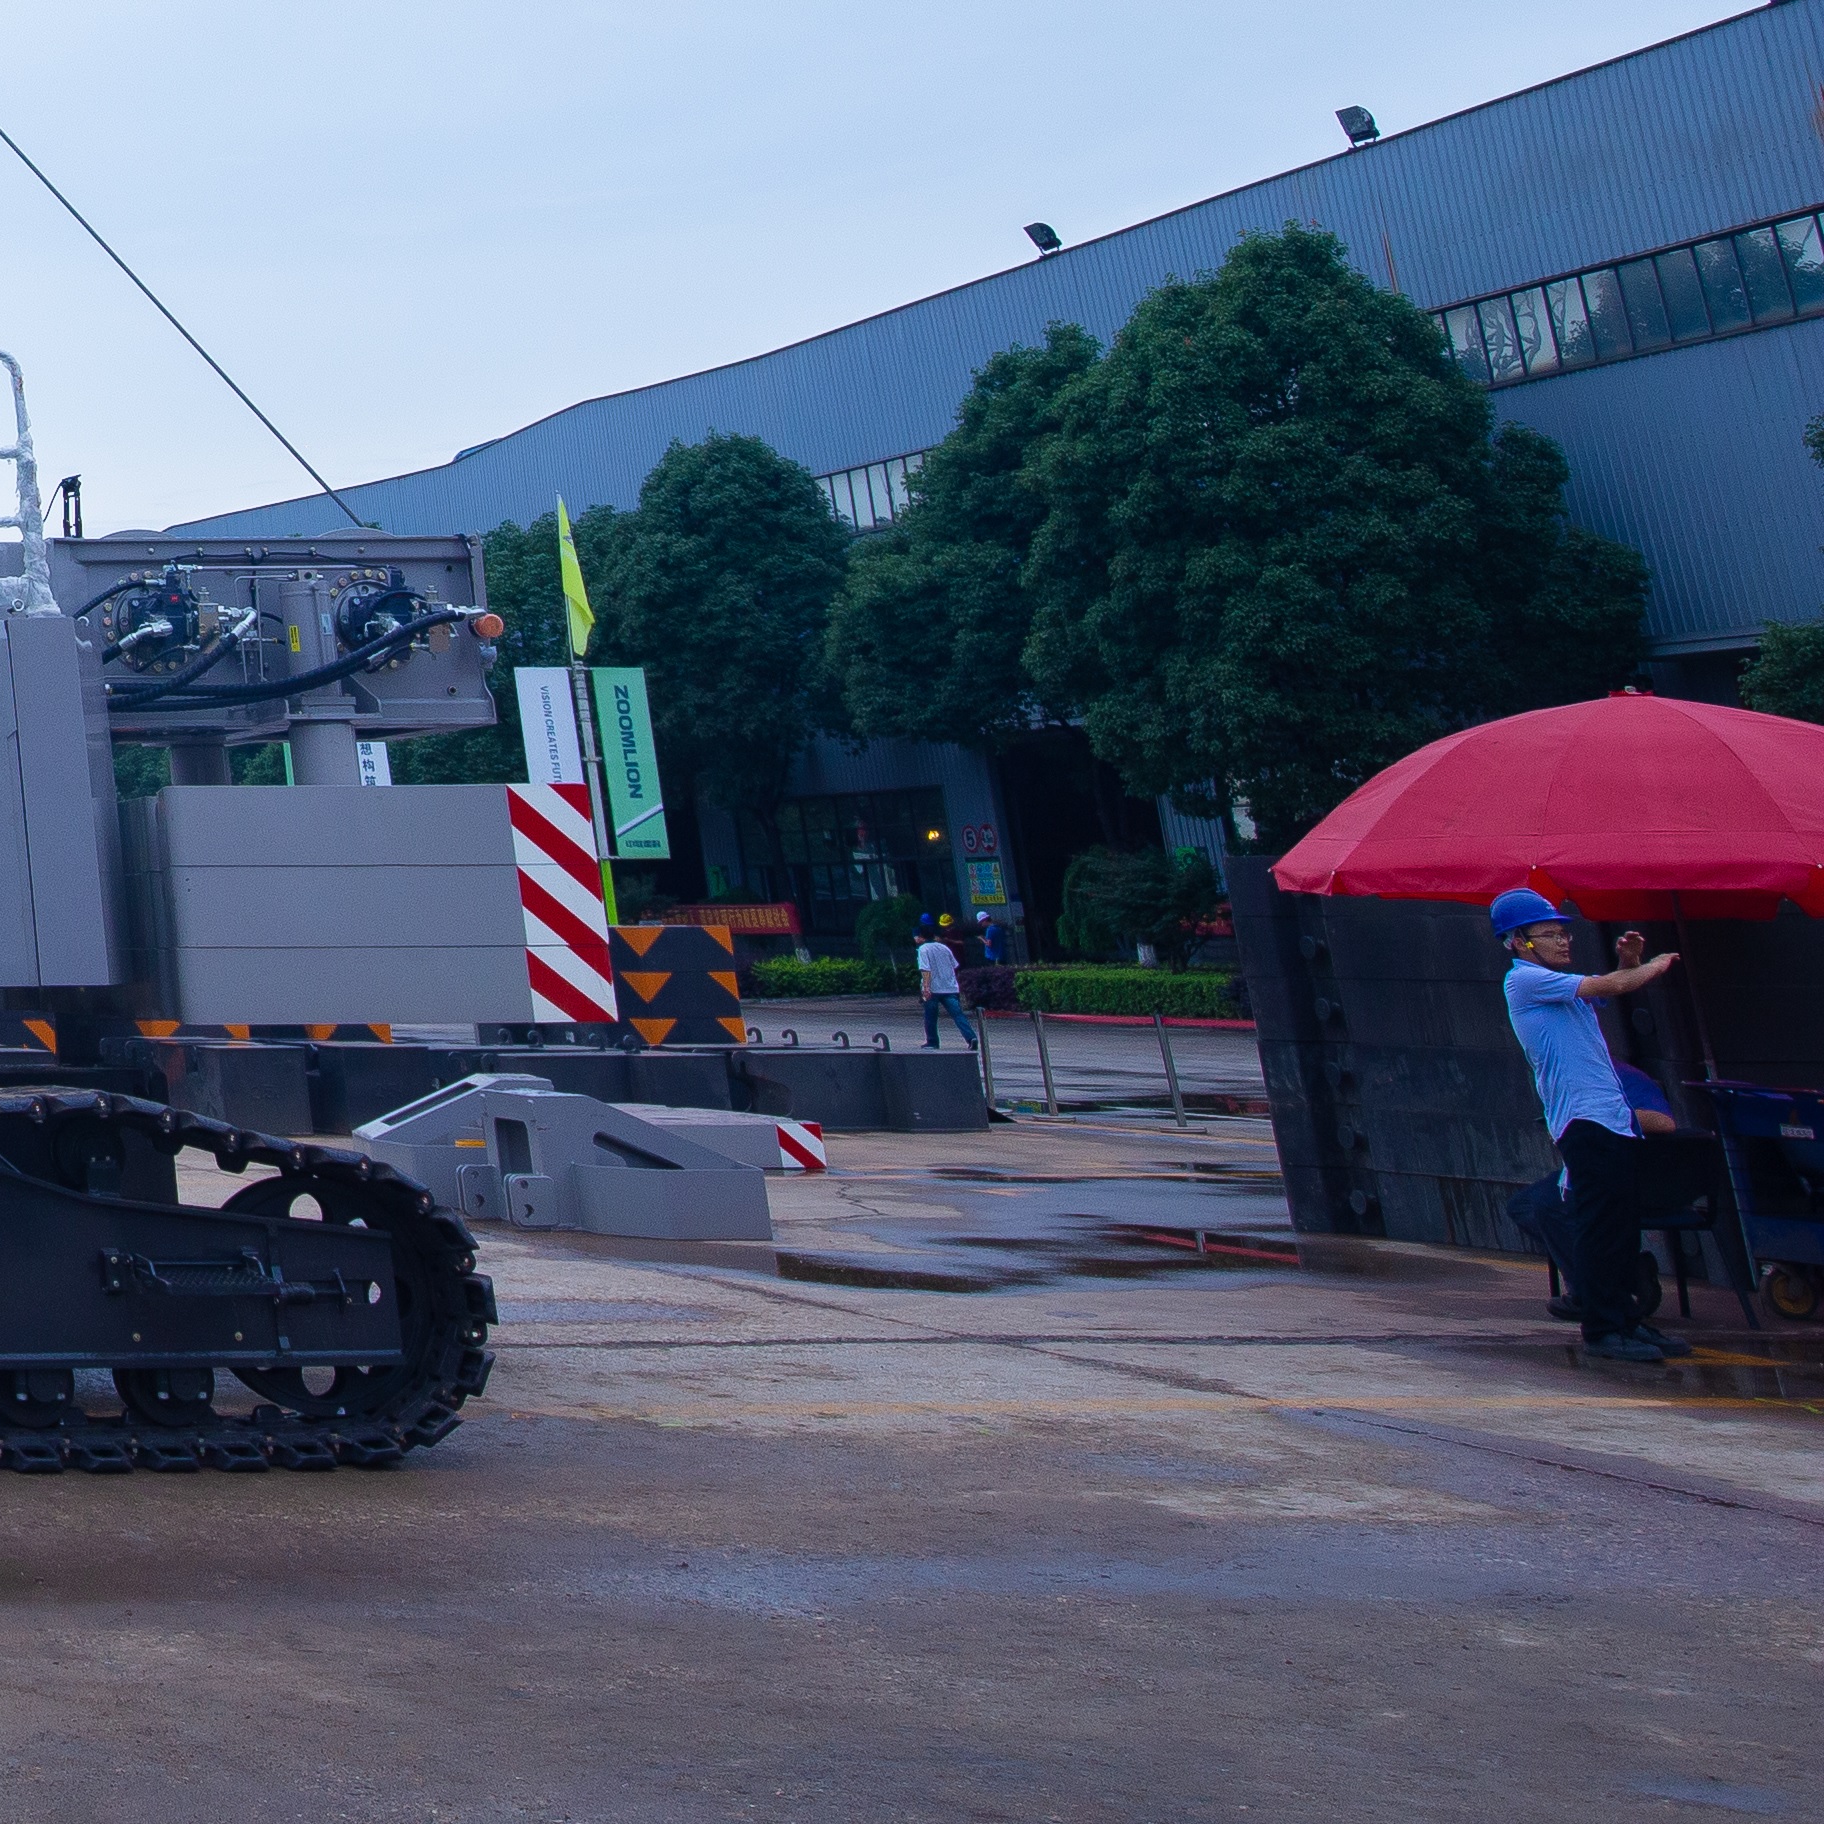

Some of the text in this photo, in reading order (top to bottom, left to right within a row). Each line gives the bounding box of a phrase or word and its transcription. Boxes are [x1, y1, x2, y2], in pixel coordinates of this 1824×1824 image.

[540, 685, 553, 720] VISION
[544, 718, 559, 764] CREATES
[613, 684, 644, 799] ZOOMLION
[965, 829, 975, 848] 5
